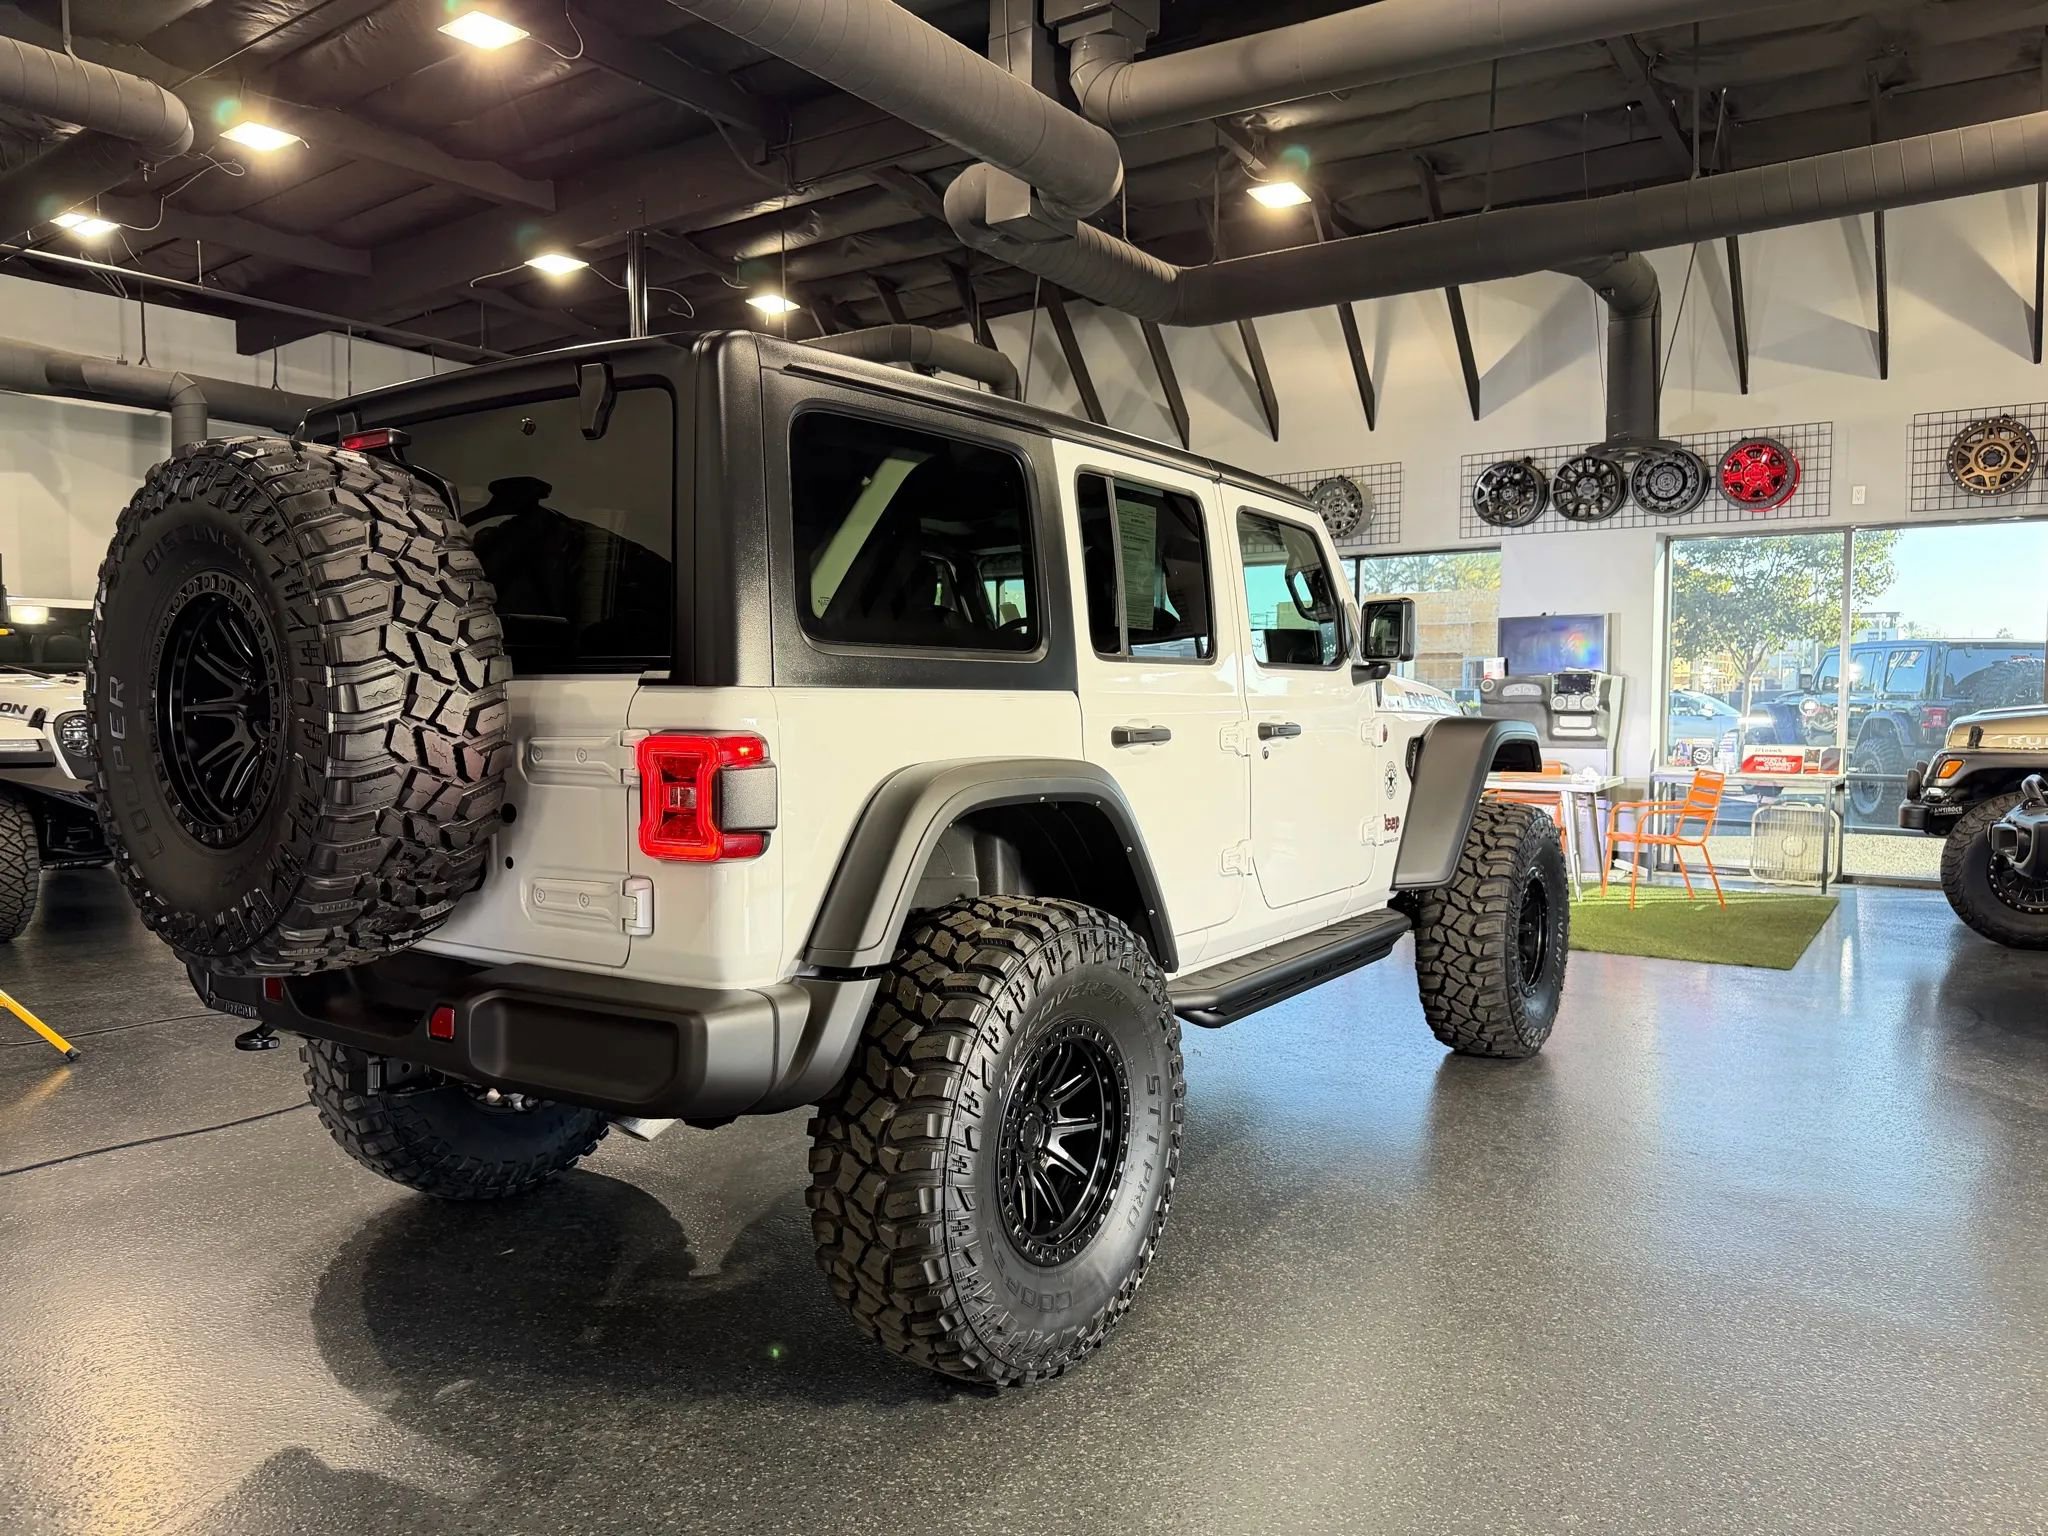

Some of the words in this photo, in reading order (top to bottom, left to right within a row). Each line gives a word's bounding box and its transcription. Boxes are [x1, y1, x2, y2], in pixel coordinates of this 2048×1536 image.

[109, 675, 165, 858] COOPER
[1146, 1073, 1162, 1156] STT
[1126, 1159, 1154, 1231] PRO
